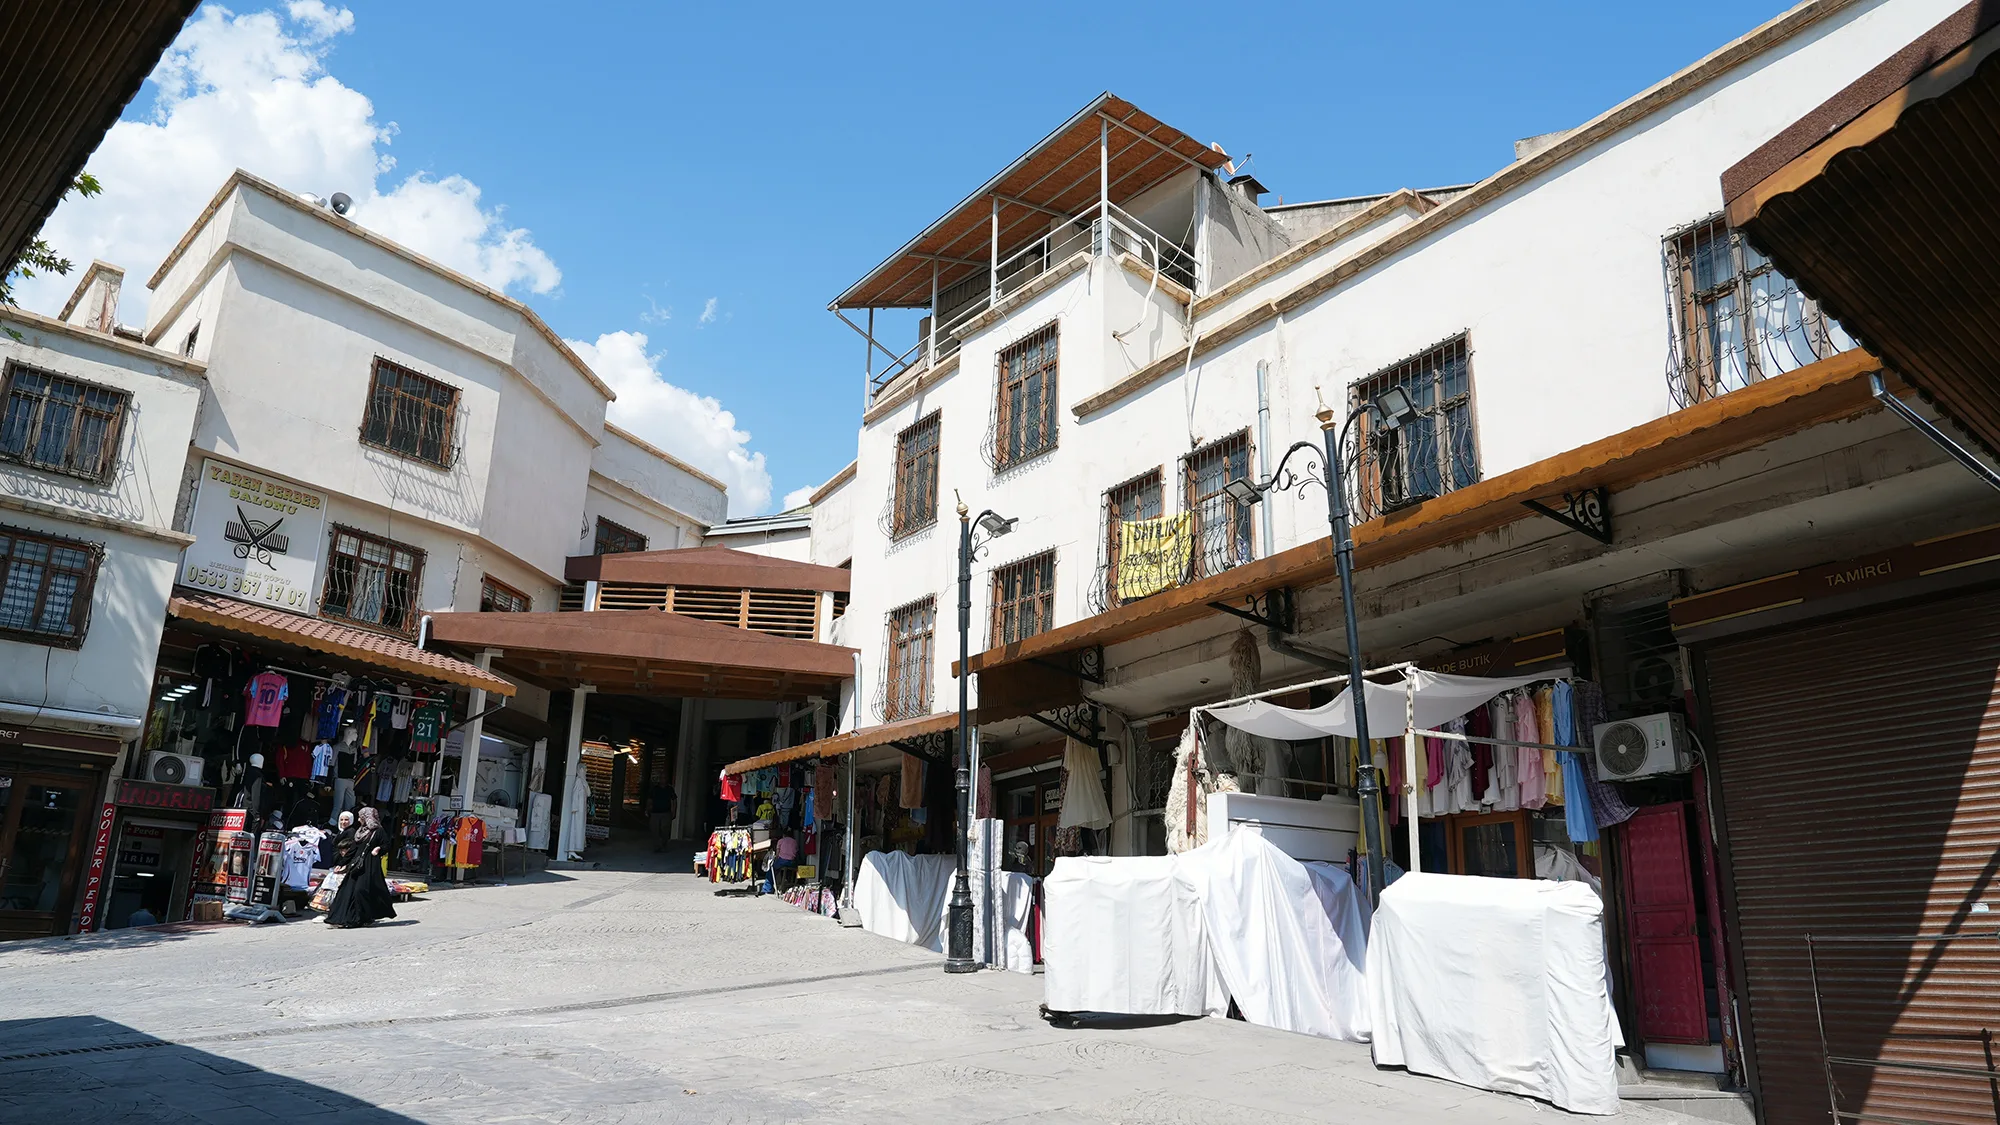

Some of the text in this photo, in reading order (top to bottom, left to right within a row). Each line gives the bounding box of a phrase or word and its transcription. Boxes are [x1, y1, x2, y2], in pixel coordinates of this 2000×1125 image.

[210, 466, 321, 509] YAREN BERBER
[229, 488, 298, 515] SALONU
[187, 564, 308, 607] 0533 967 17 07
[1824, 558, 1893, 587] TAMİRCİ
[1428, 652, 1491, 674] ZADE BUTİK
[259, 688, 276, 705] 10
[416, 721, 433, 738] 21
[119, 782, 212, 811] İNDİRİM
[225, 815, 243, 828] PERDE
